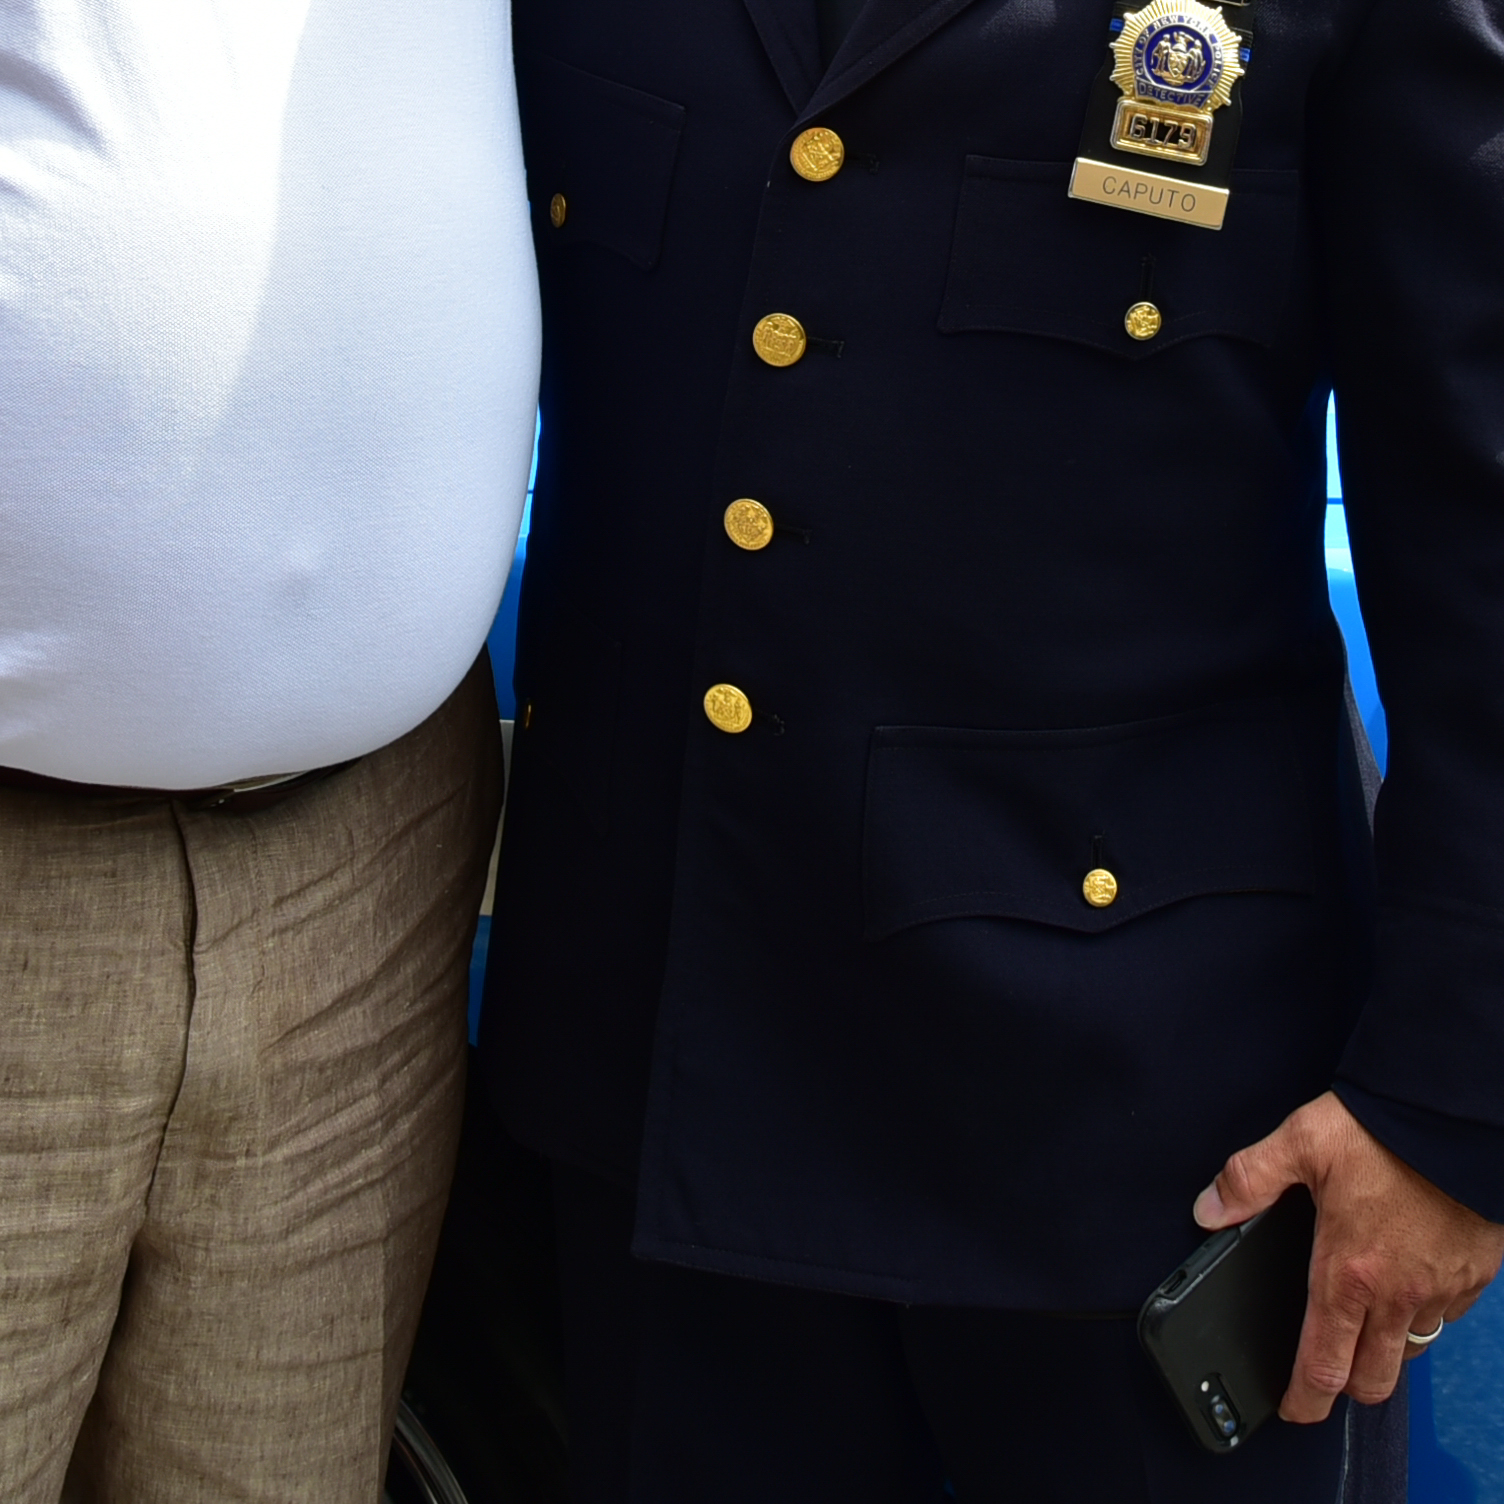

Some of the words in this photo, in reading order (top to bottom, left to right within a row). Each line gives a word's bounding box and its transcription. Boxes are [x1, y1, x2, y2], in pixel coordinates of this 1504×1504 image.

[1153, 15, 1179, 30] NEW
[1138, 82, 1205, 107] DETECTIVE
[1130, 113, 1197, 149] 6179
[1102, 175, 1196, 213] CAPUTO
